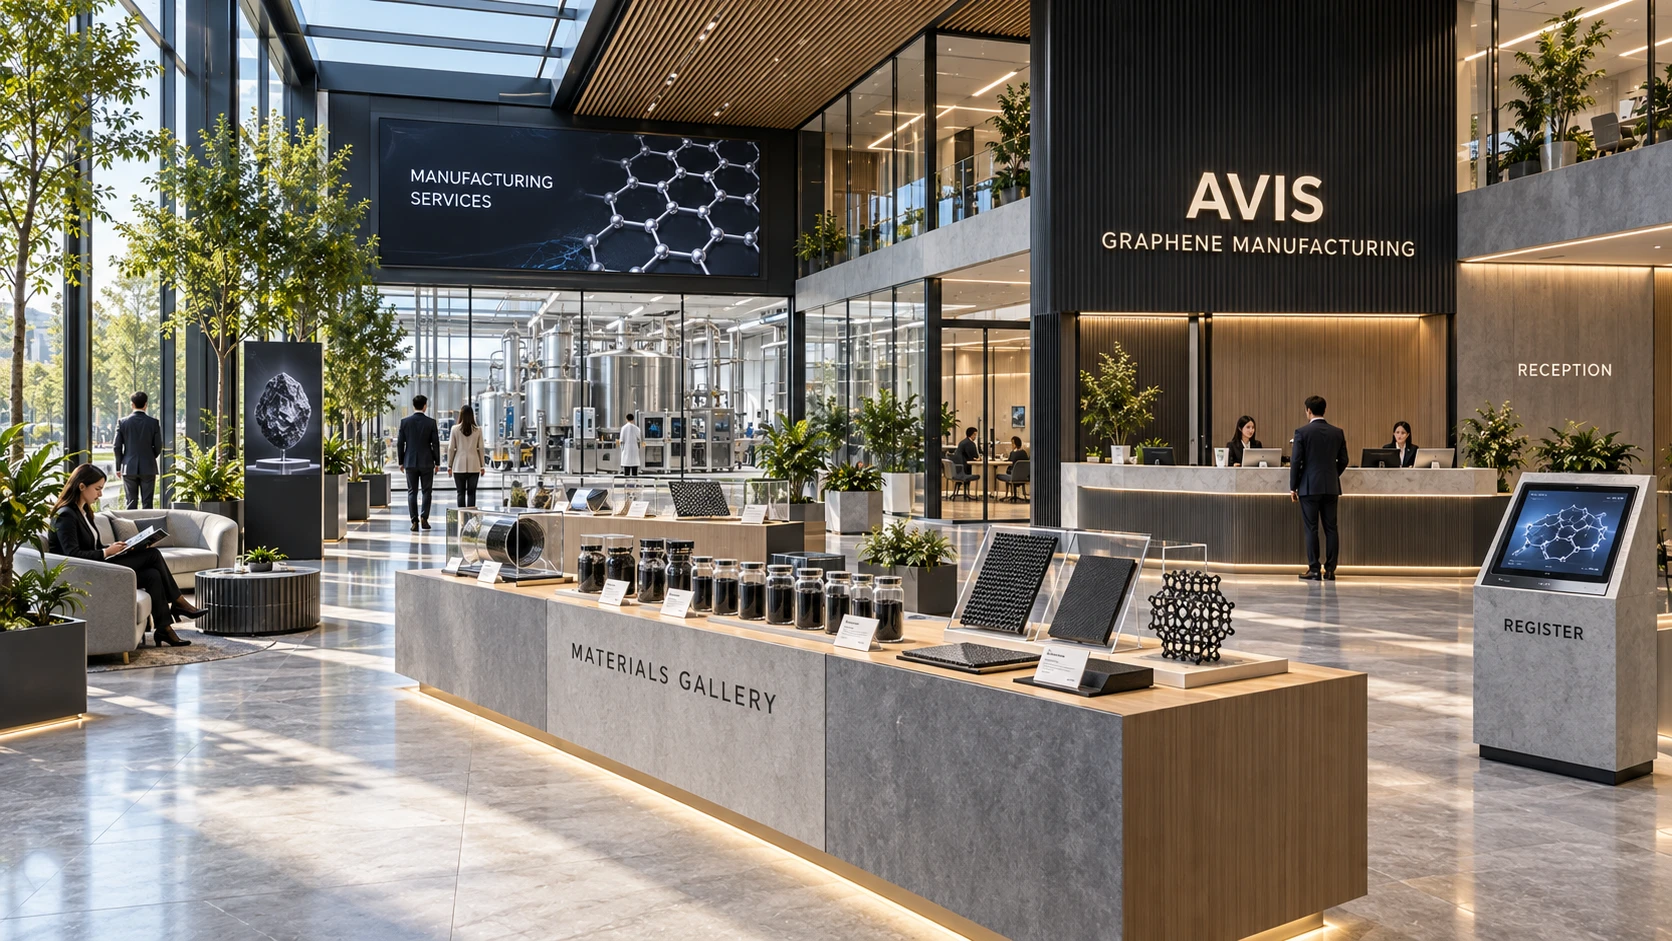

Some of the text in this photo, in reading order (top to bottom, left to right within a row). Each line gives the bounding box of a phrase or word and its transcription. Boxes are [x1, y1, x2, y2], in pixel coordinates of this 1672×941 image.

[410, 169, 553, 189] MANUFACTURING
[410, 191, 492, 208] SERVICES
[1186, 171, 1324, 223] AVIS
[1101, 231, 1416, 257] GRAPHENE MANUFACTURING
[1518, 363, 1612, 377] RECEPTION
[1504, 618, 1584, 641] REGISTER
[571, 642, 776, 714] MATERIALS GALLERY
